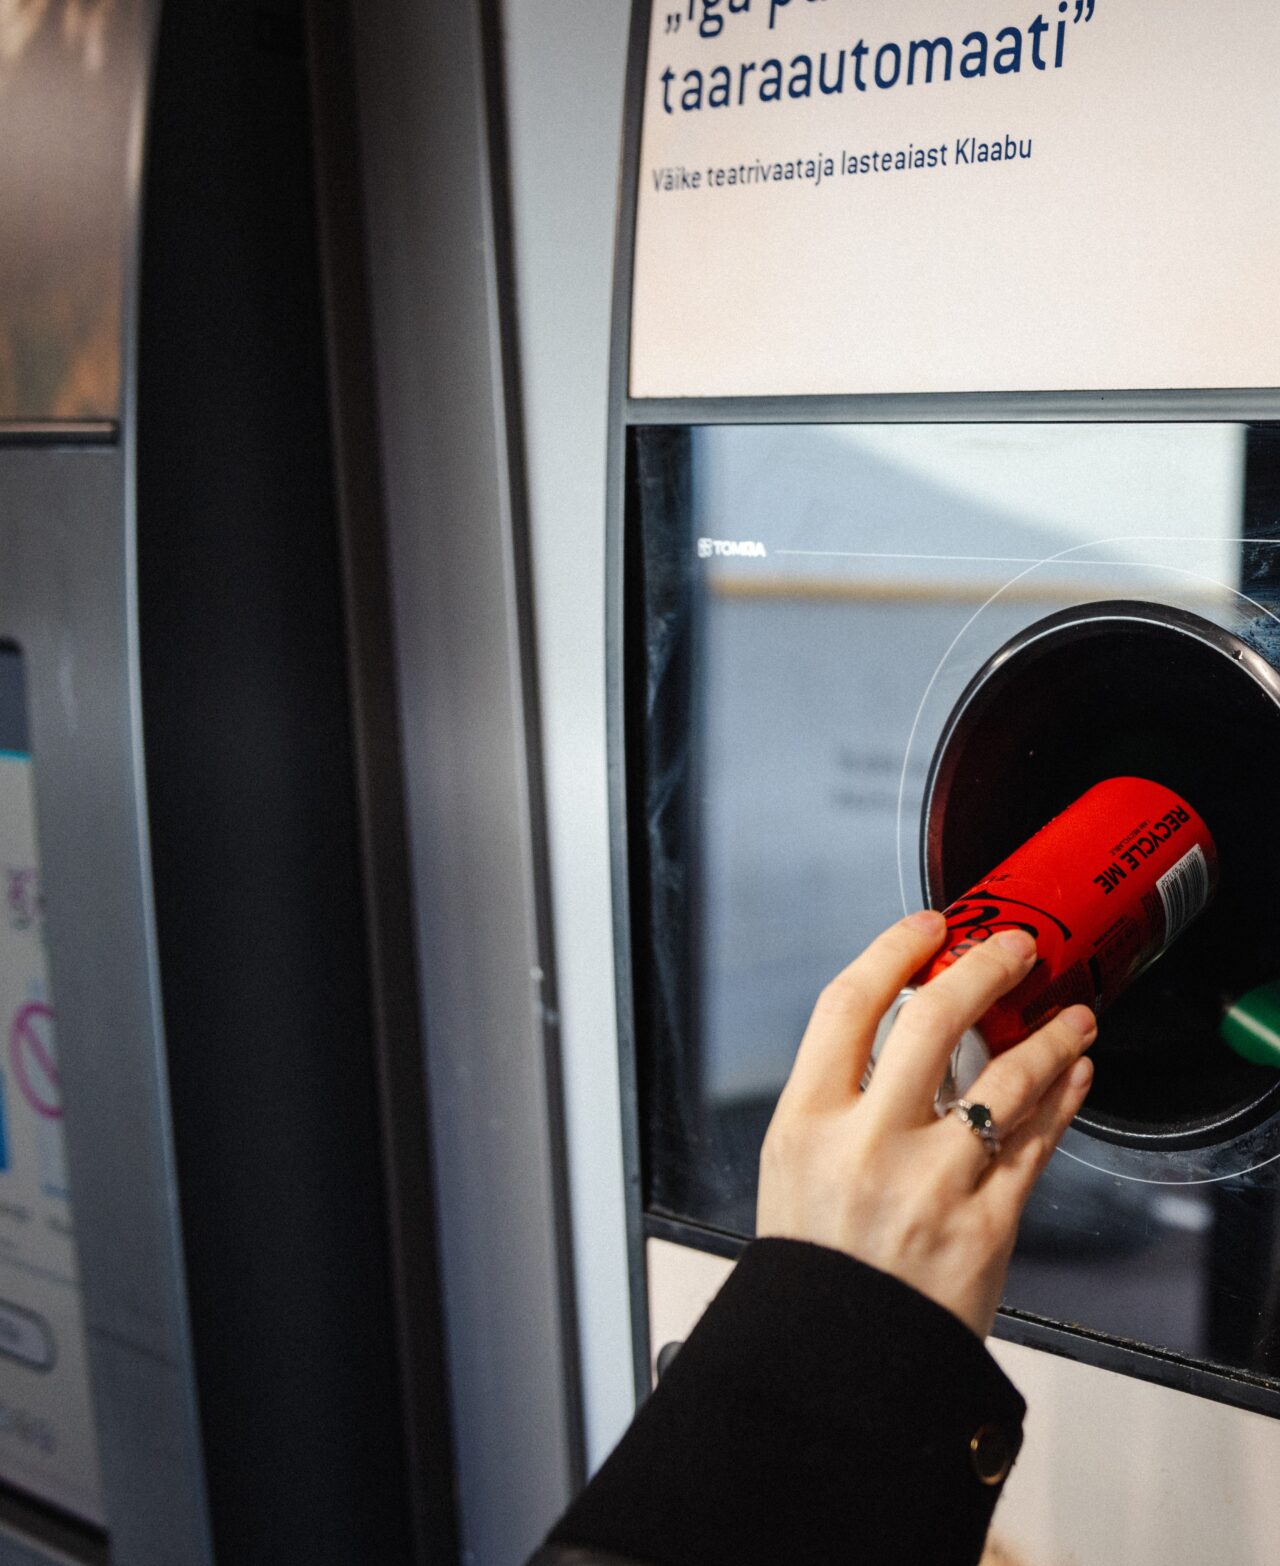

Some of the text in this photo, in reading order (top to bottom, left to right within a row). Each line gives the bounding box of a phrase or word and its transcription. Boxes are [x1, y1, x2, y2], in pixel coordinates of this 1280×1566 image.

[666, 0, 749, 38] „g
[661, 0, 1096, 115] taaraautomaati”
[652, 133, 1032, 192] Väike teatrivaataja lasteaiast Klaabu
[1092, 804, 1191, 896] RECYCLE ME
